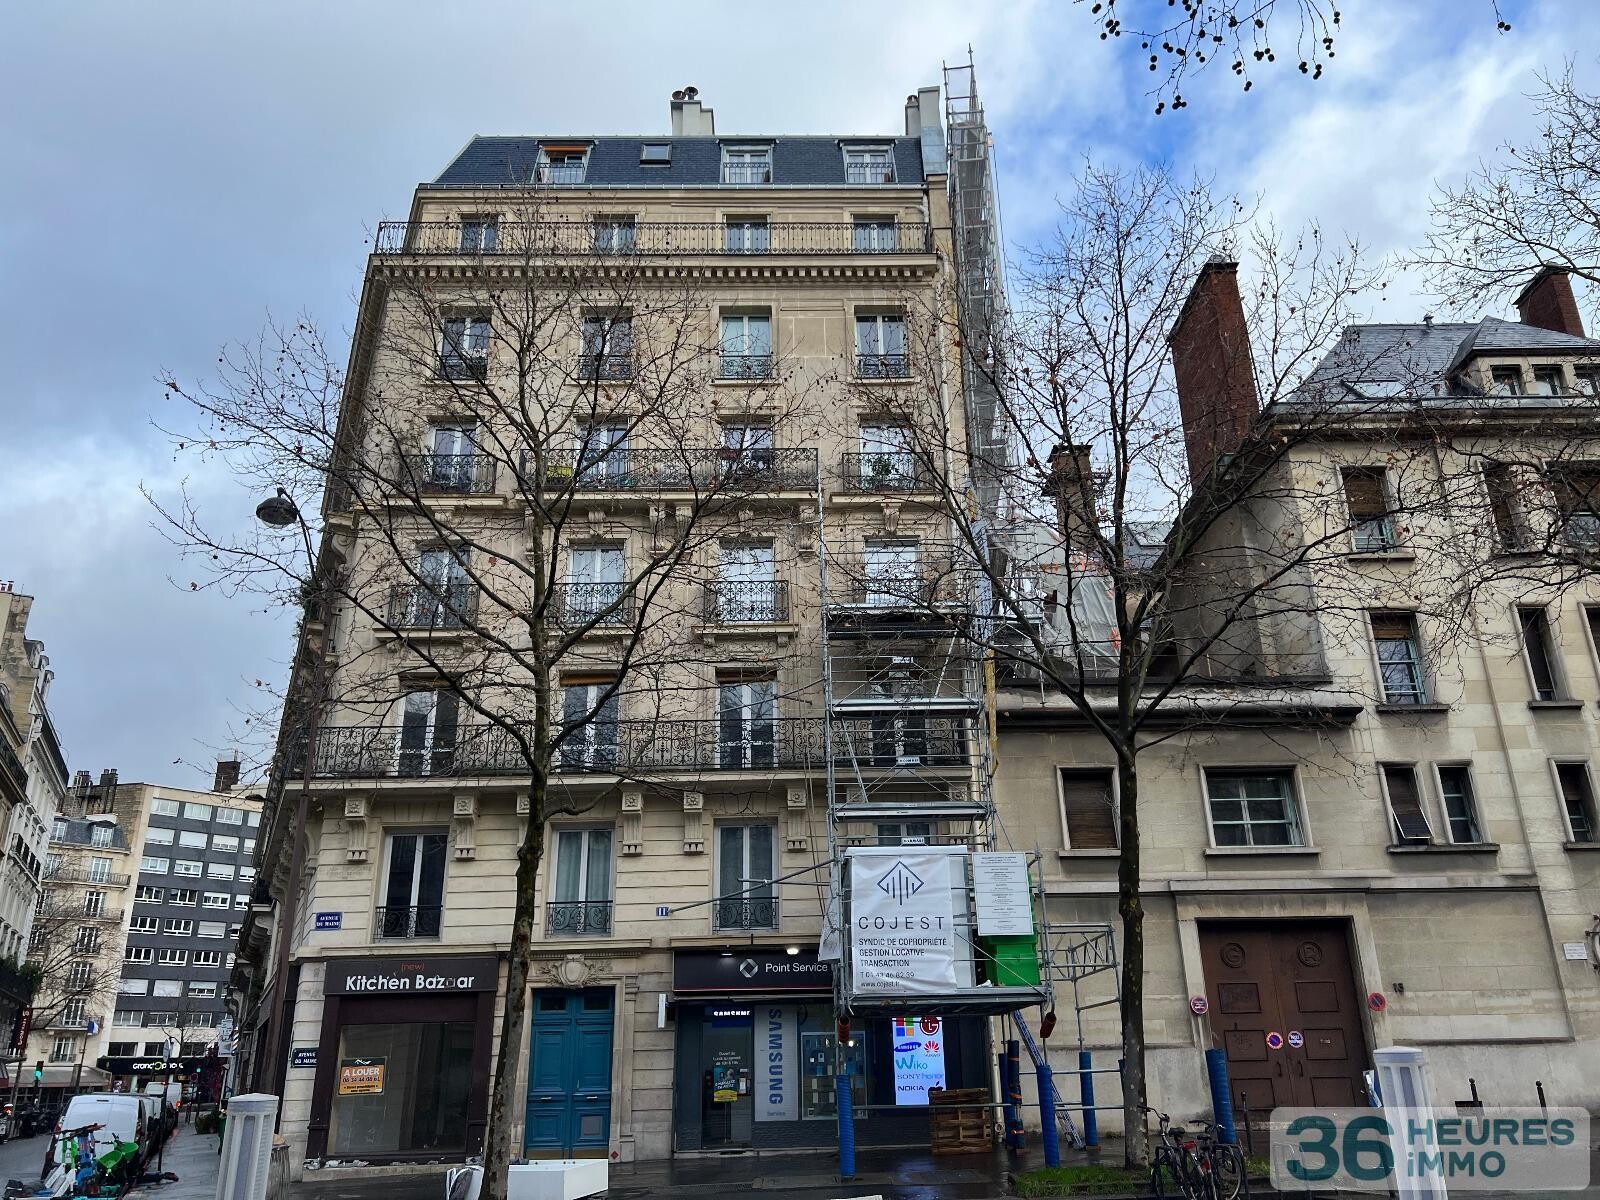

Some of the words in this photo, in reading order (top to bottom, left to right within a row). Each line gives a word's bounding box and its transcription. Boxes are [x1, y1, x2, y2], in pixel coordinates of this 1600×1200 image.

[858, 916, 945, 930] COJEST
[858, 938, 886, 946] SYNDIC
[887, 938, 897, 946] DE
[898, 937, 947, 946] COPROPRIÉTÉ
[859, 948, 890, 957] GESTION
[891, 948, 925, 957] LOCATIVE
[765, 963, 790, 973] Point
[792, 962, 828, 972] Service
[860, 959, 910, 967] TRANSACTION
[345, 975, 410, 991] Kitchen
[768, 1008, 784, 1105] SAMSUNG
[352, 1067, 380, 1076] LOUER
